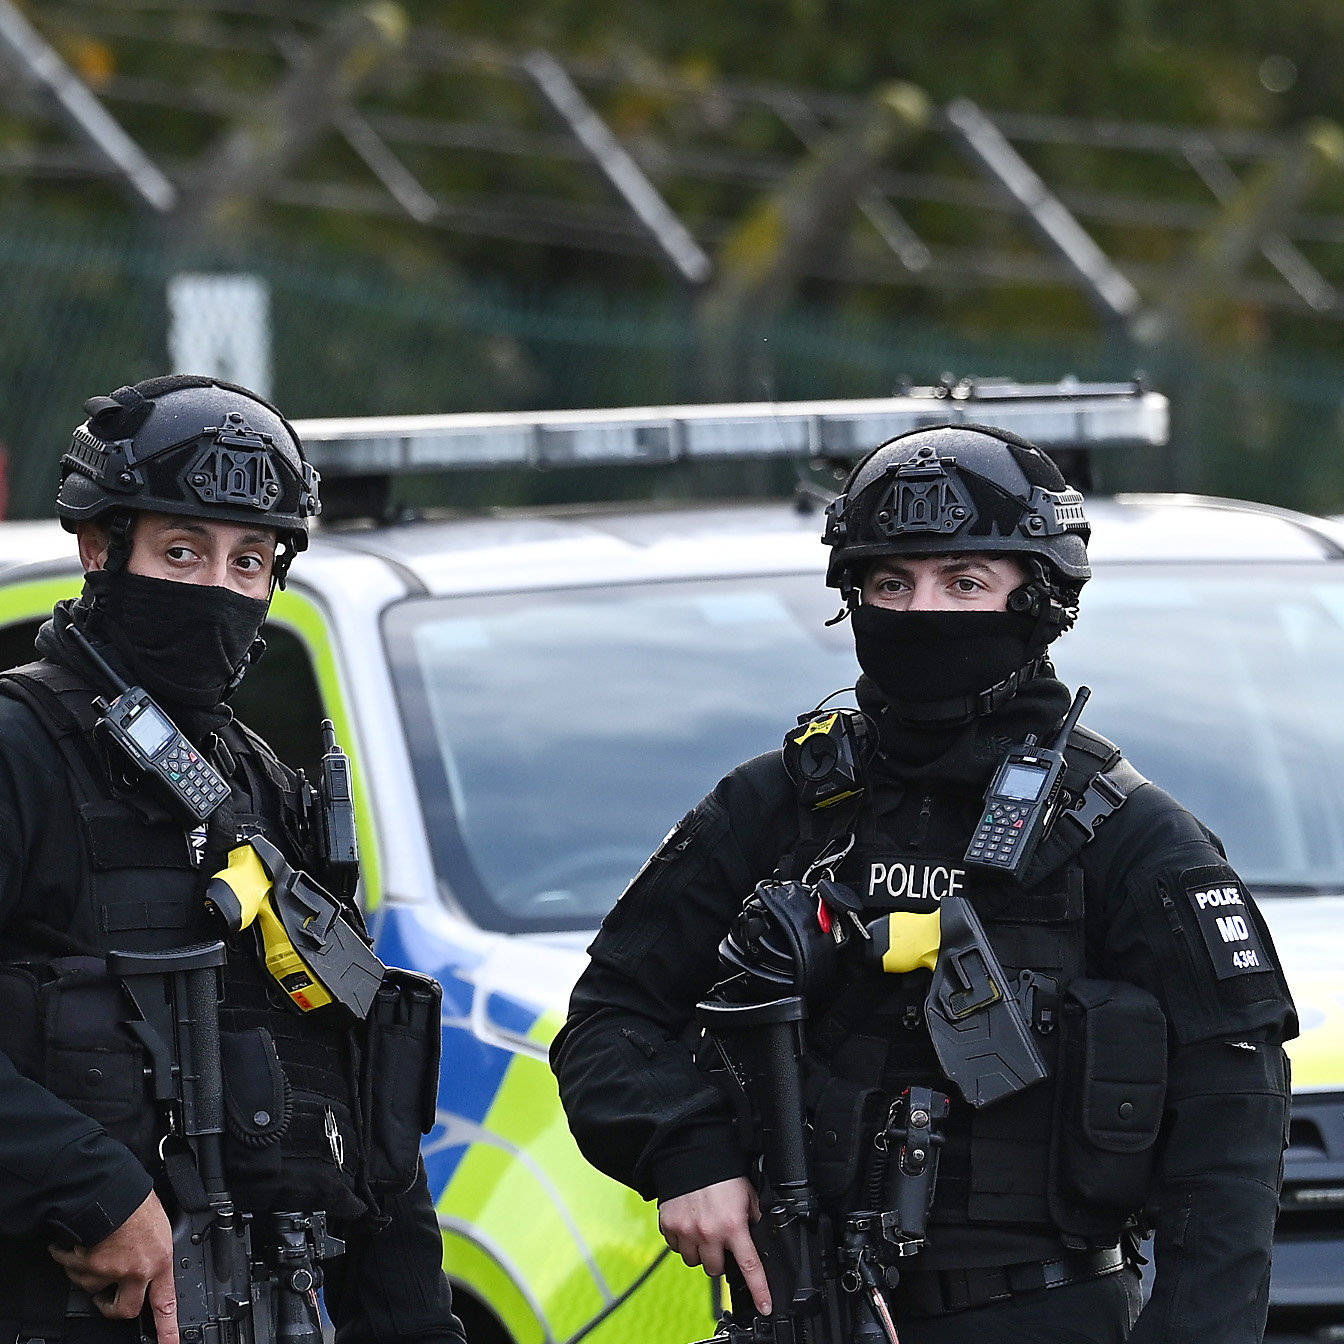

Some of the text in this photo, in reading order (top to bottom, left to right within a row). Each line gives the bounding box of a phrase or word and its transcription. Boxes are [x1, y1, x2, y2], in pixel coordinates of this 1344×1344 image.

[868, 862, 966, 902] POLICE
[1194, 887, 1245, 910] POLICE
[1215, 915, 1250, 943] MD
[1232, 949, 1260, 969] 4361
